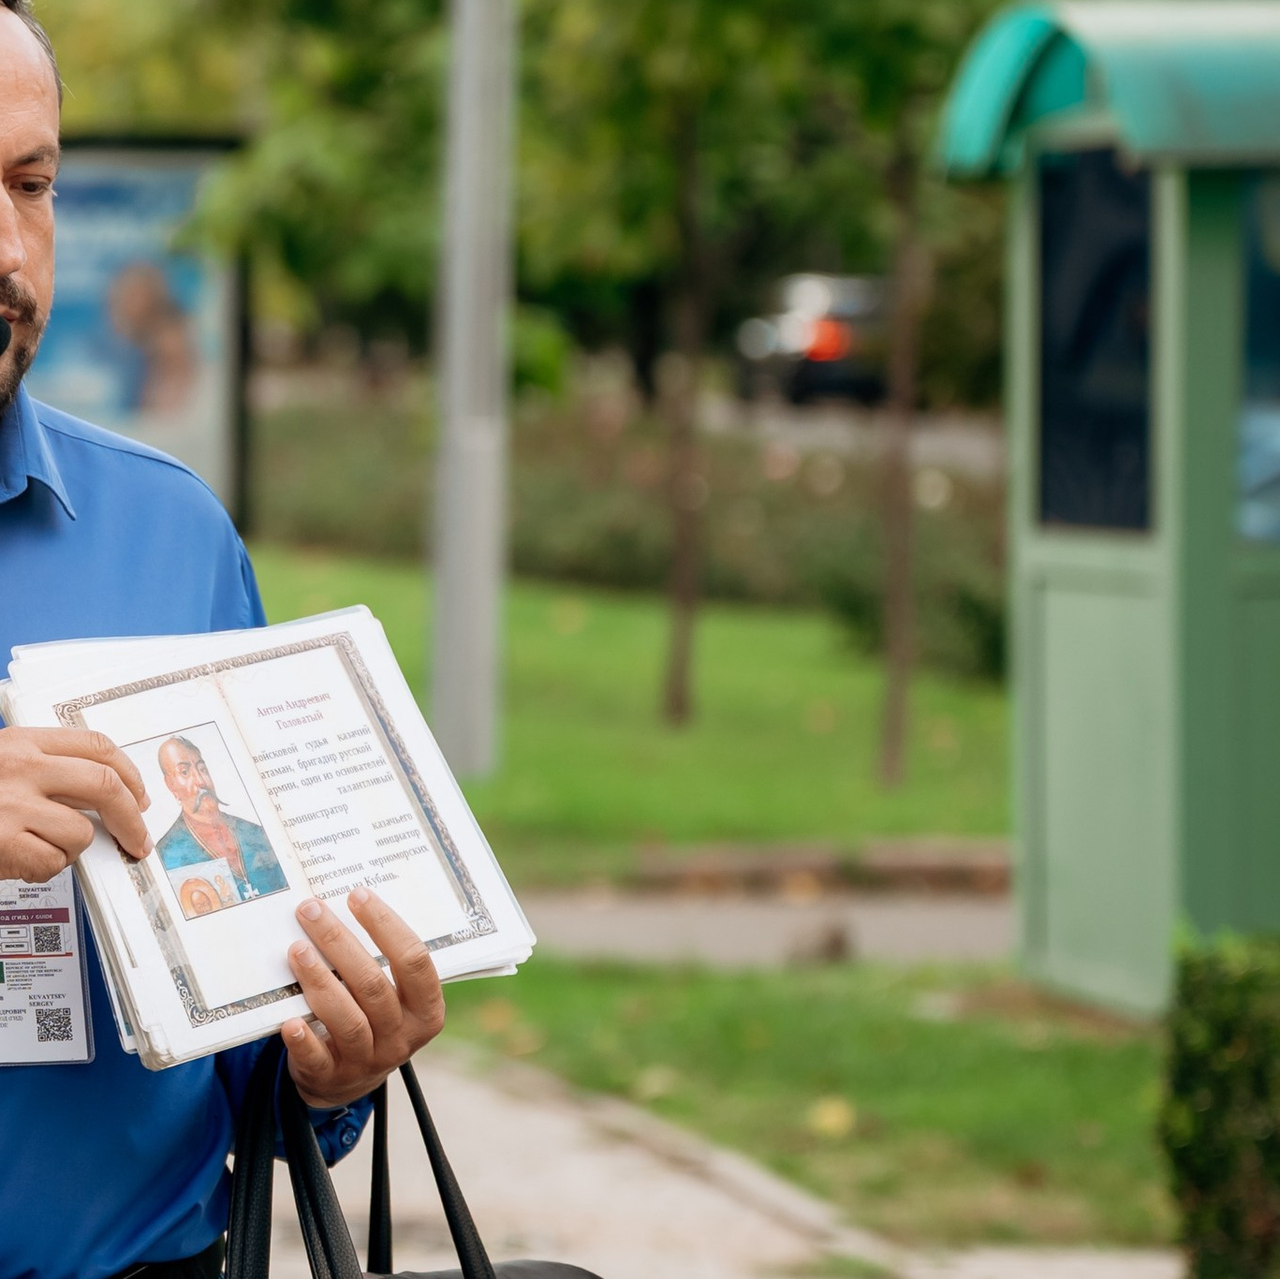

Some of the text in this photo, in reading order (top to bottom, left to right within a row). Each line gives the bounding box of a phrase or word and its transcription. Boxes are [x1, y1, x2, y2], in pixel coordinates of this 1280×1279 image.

[257, 691, 331, 717] Антон Андреевич
[275, 710, 324, 731] Головатый
[253, 724, 371, 763] войсковой судья казачий
[260, 742, 372, 780] атаман, бригадир русской
[267, 756, 387, 797] армии, один из основателей
[337, 773, 394, 795] талантливый
[282, 803, 349, 828] администратор
[292, 812, 413, 853] Черноморского казачьего
[301, 828, 421, 869] войска, инициатор
[308, 844, 429, 887] переселения черноморских
[315, 884, 351, 901] казаков
[364, 872, 400, 889] Кубань.
